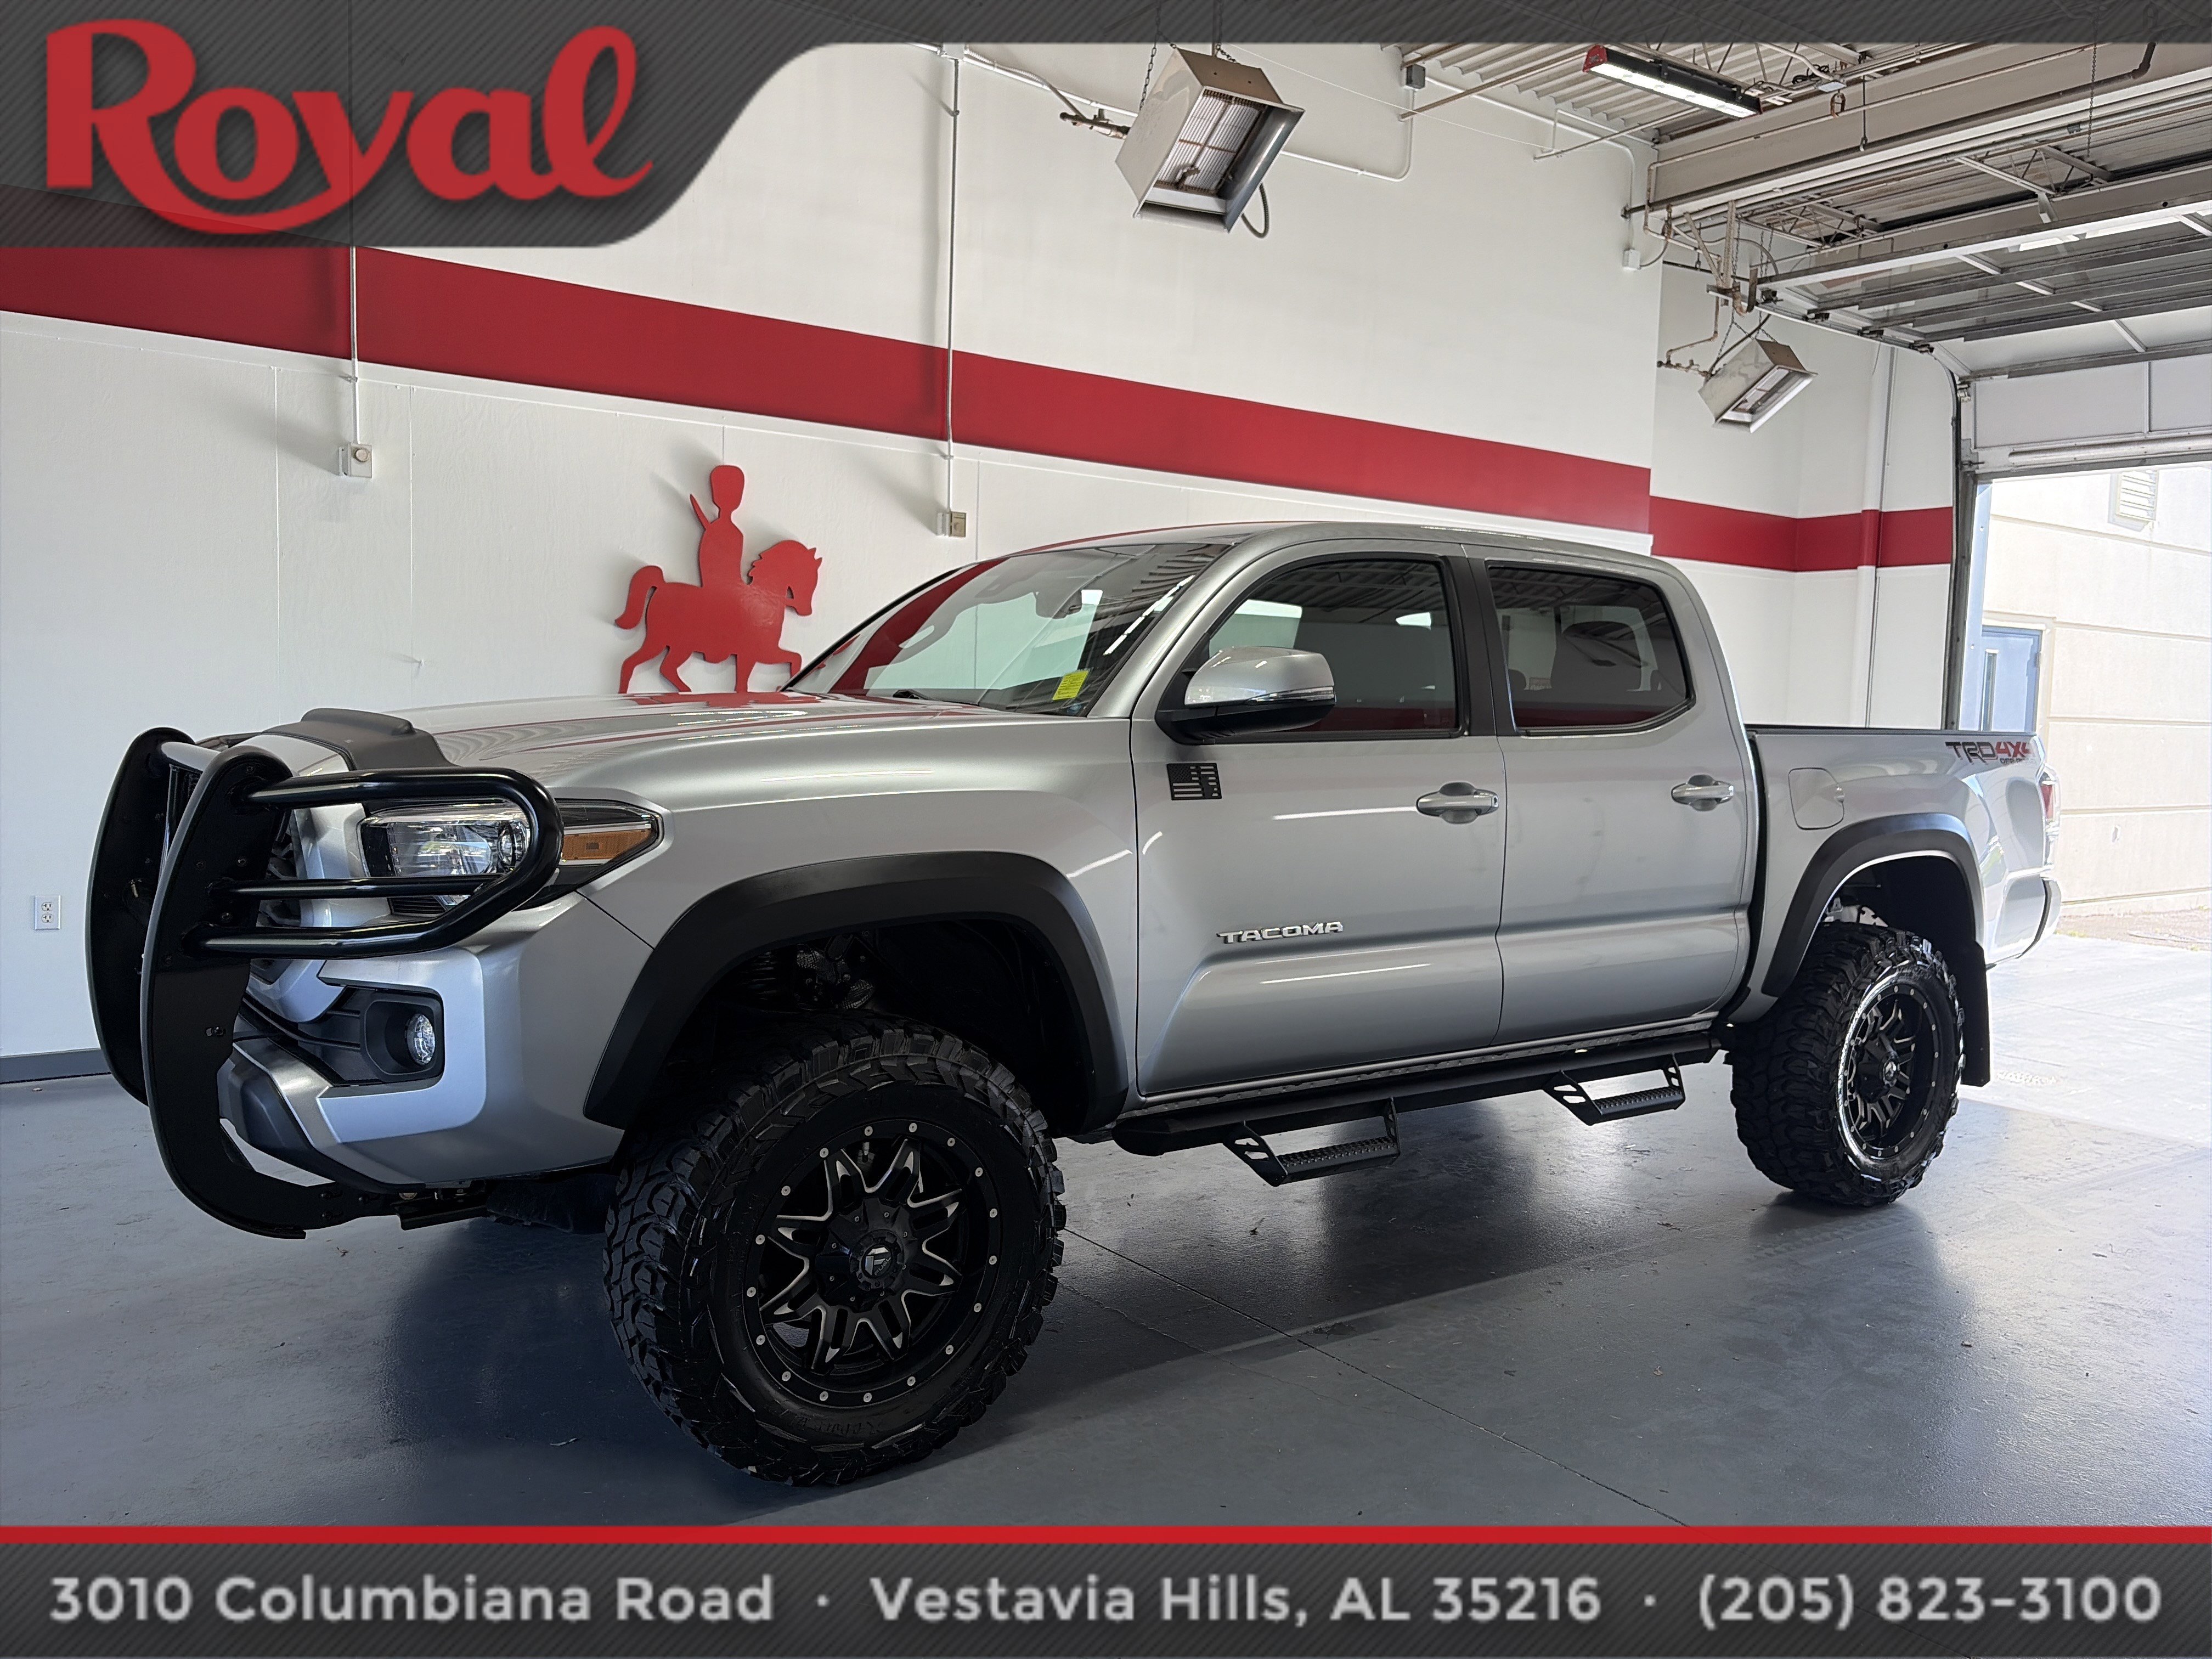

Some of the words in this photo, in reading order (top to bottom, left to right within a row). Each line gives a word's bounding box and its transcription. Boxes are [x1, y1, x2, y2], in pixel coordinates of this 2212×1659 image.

[1945, 742, 1997, 764] TRD
[1217, 921, 1344, 944] TACOMA
[874, 1257, 891, 1276] FUEL
